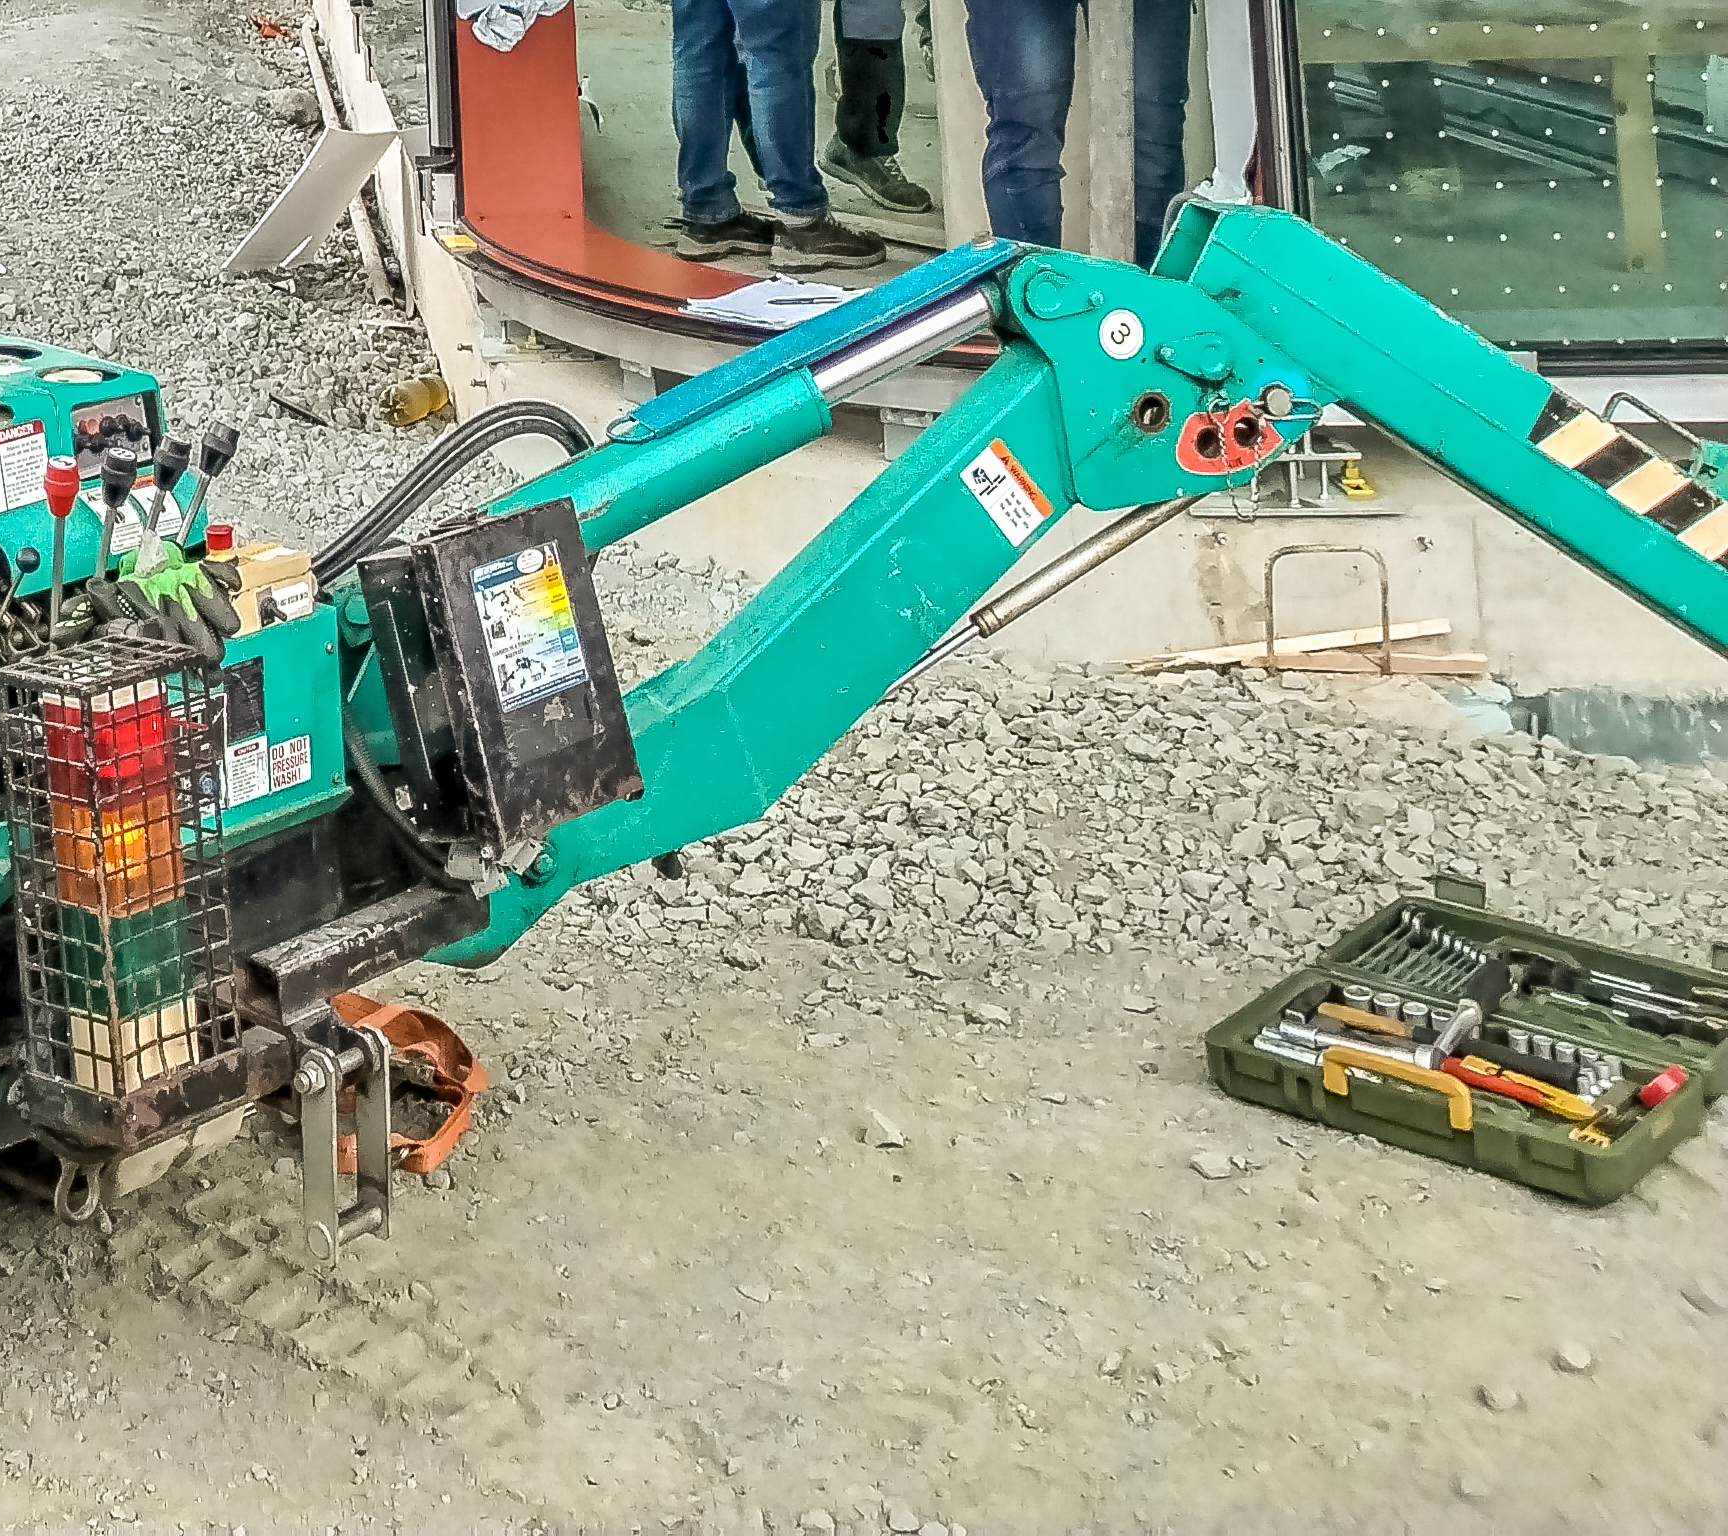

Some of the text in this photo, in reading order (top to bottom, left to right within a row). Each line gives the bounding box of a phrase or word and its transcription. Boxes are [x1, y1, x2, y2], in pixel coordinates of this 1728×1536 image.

[1109, 321, 1132, 346] 3
[272, 738, 308, 760] DO NOT
[272, 751, 308, 775] PRESSURE
